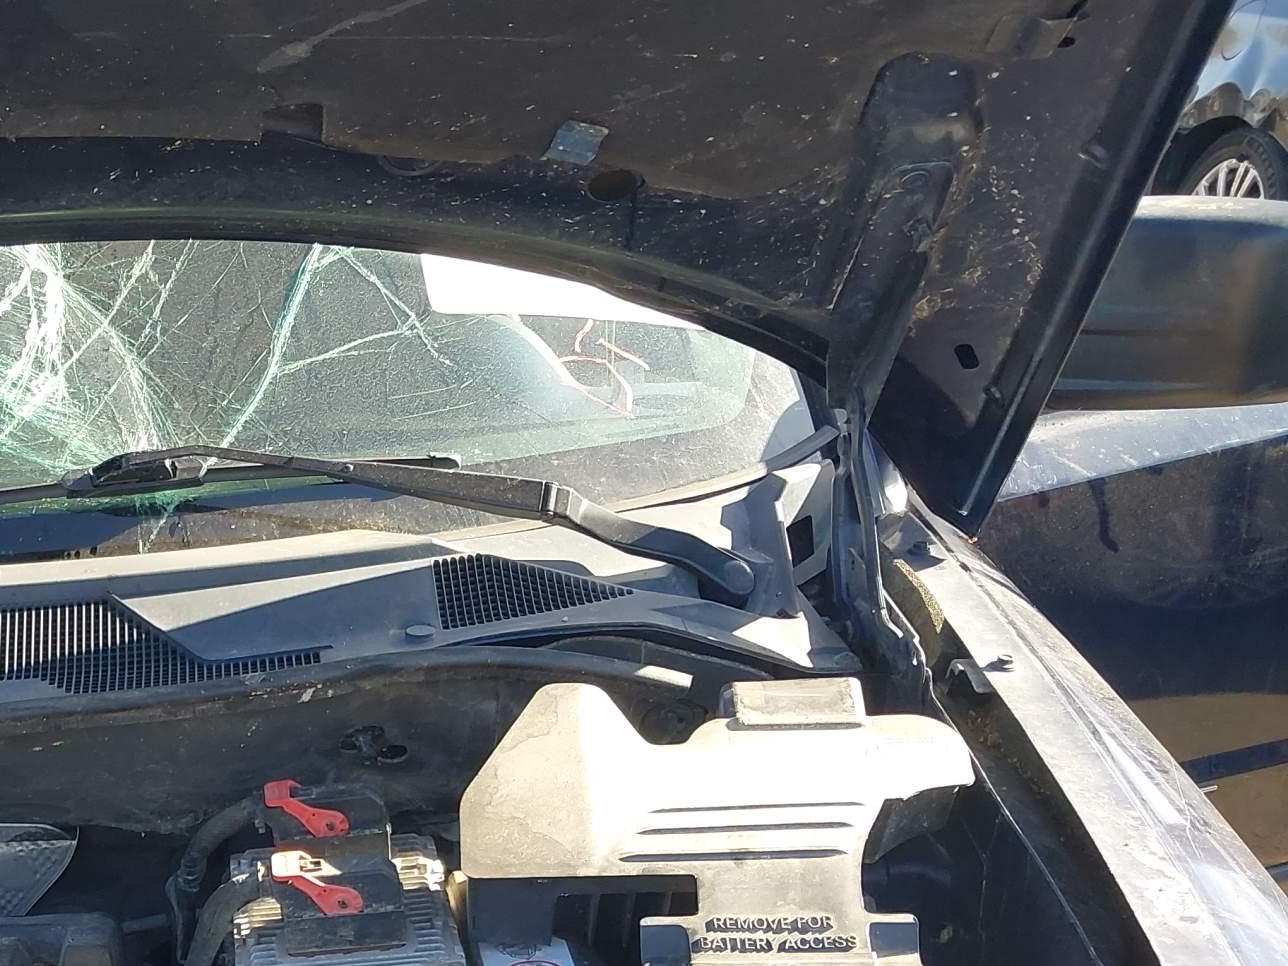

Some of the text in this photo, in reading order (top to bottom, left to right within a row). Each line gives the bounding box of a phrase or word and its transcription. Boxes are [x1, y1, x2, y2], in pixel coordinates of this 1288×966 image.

[710, 914, 833, 931] REMOVE FOR
[697, 934, 858, 951] BATTERY ACCESS
